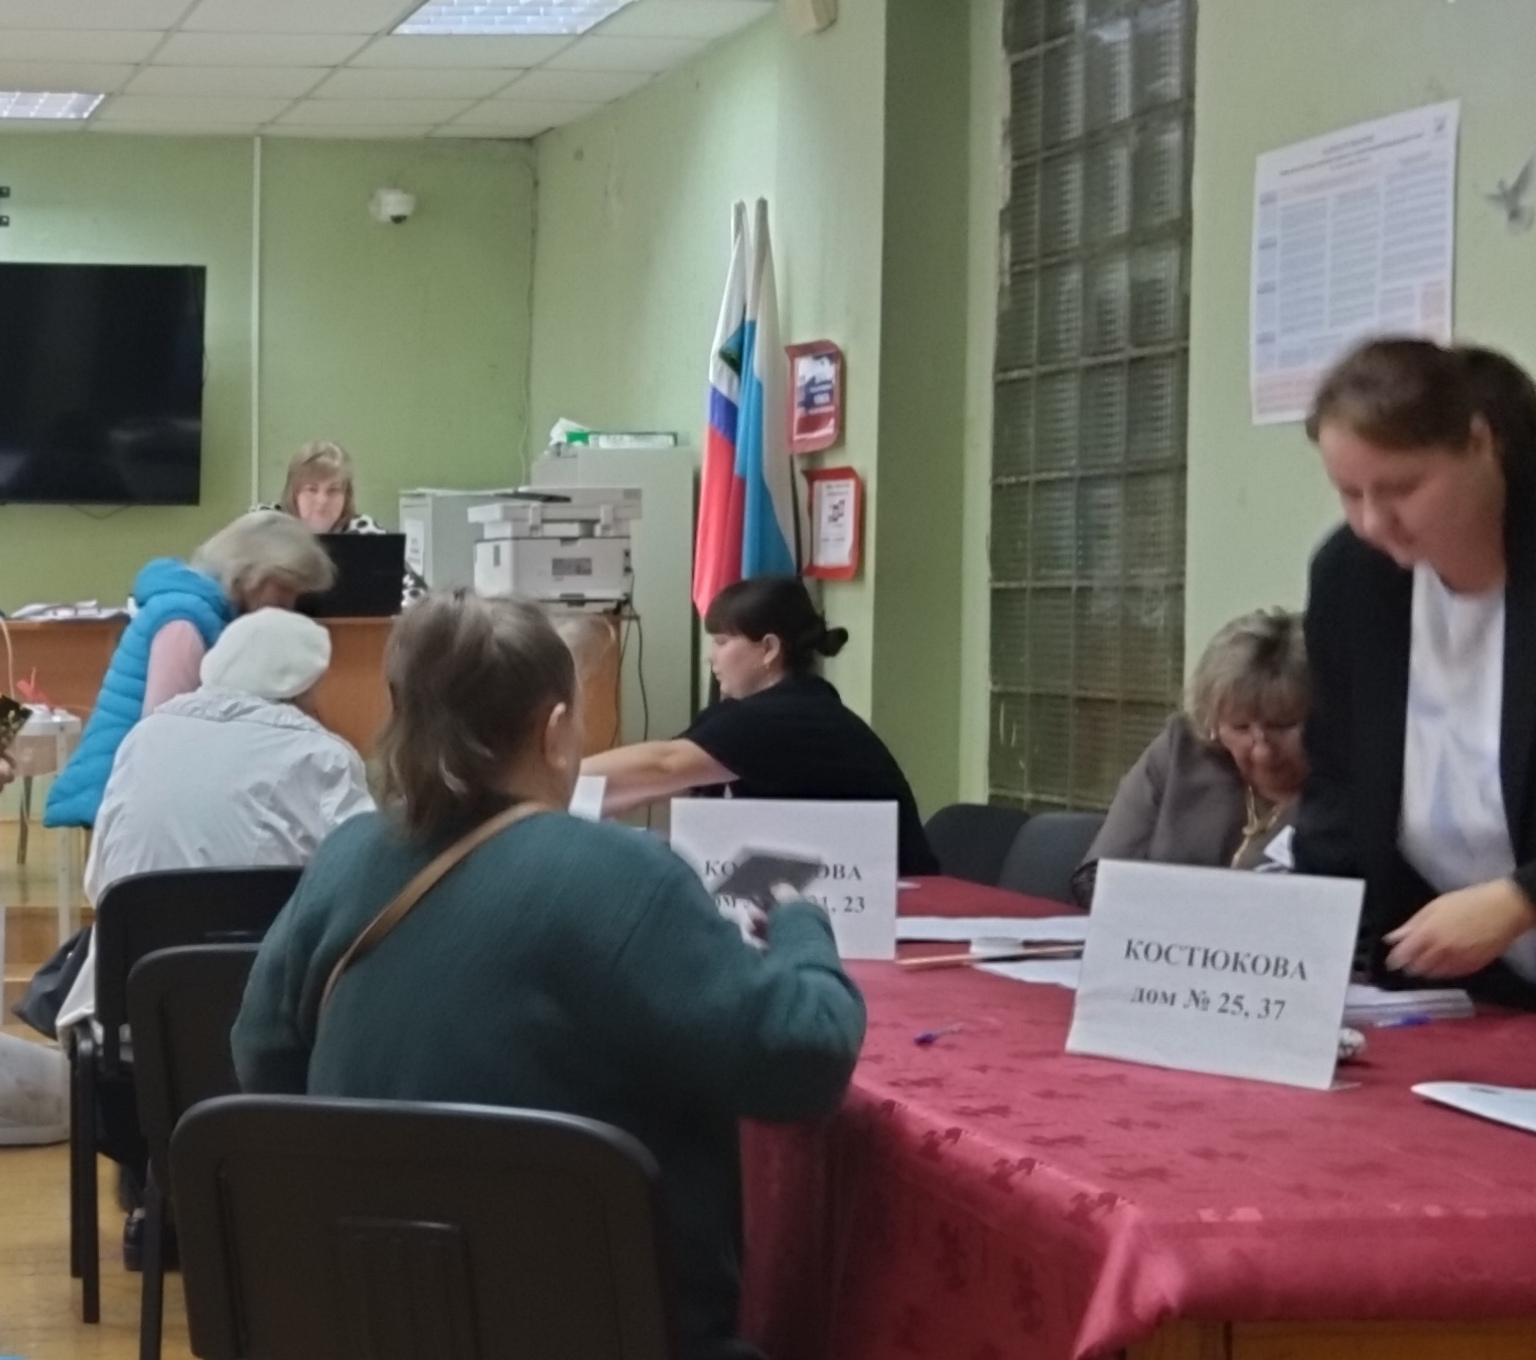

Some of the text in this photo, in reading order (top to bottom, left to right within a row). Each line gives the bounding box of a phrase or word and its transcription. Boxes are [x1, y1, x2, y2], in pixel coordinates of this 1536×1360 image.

[705, 860, 862, 881] КООВА
[843, 895, 865, 914] 23
[1124, 938, 1308, 981] КОСТЮКОВА
[1130, 987, 1286, 1021] дом № 25, 37
